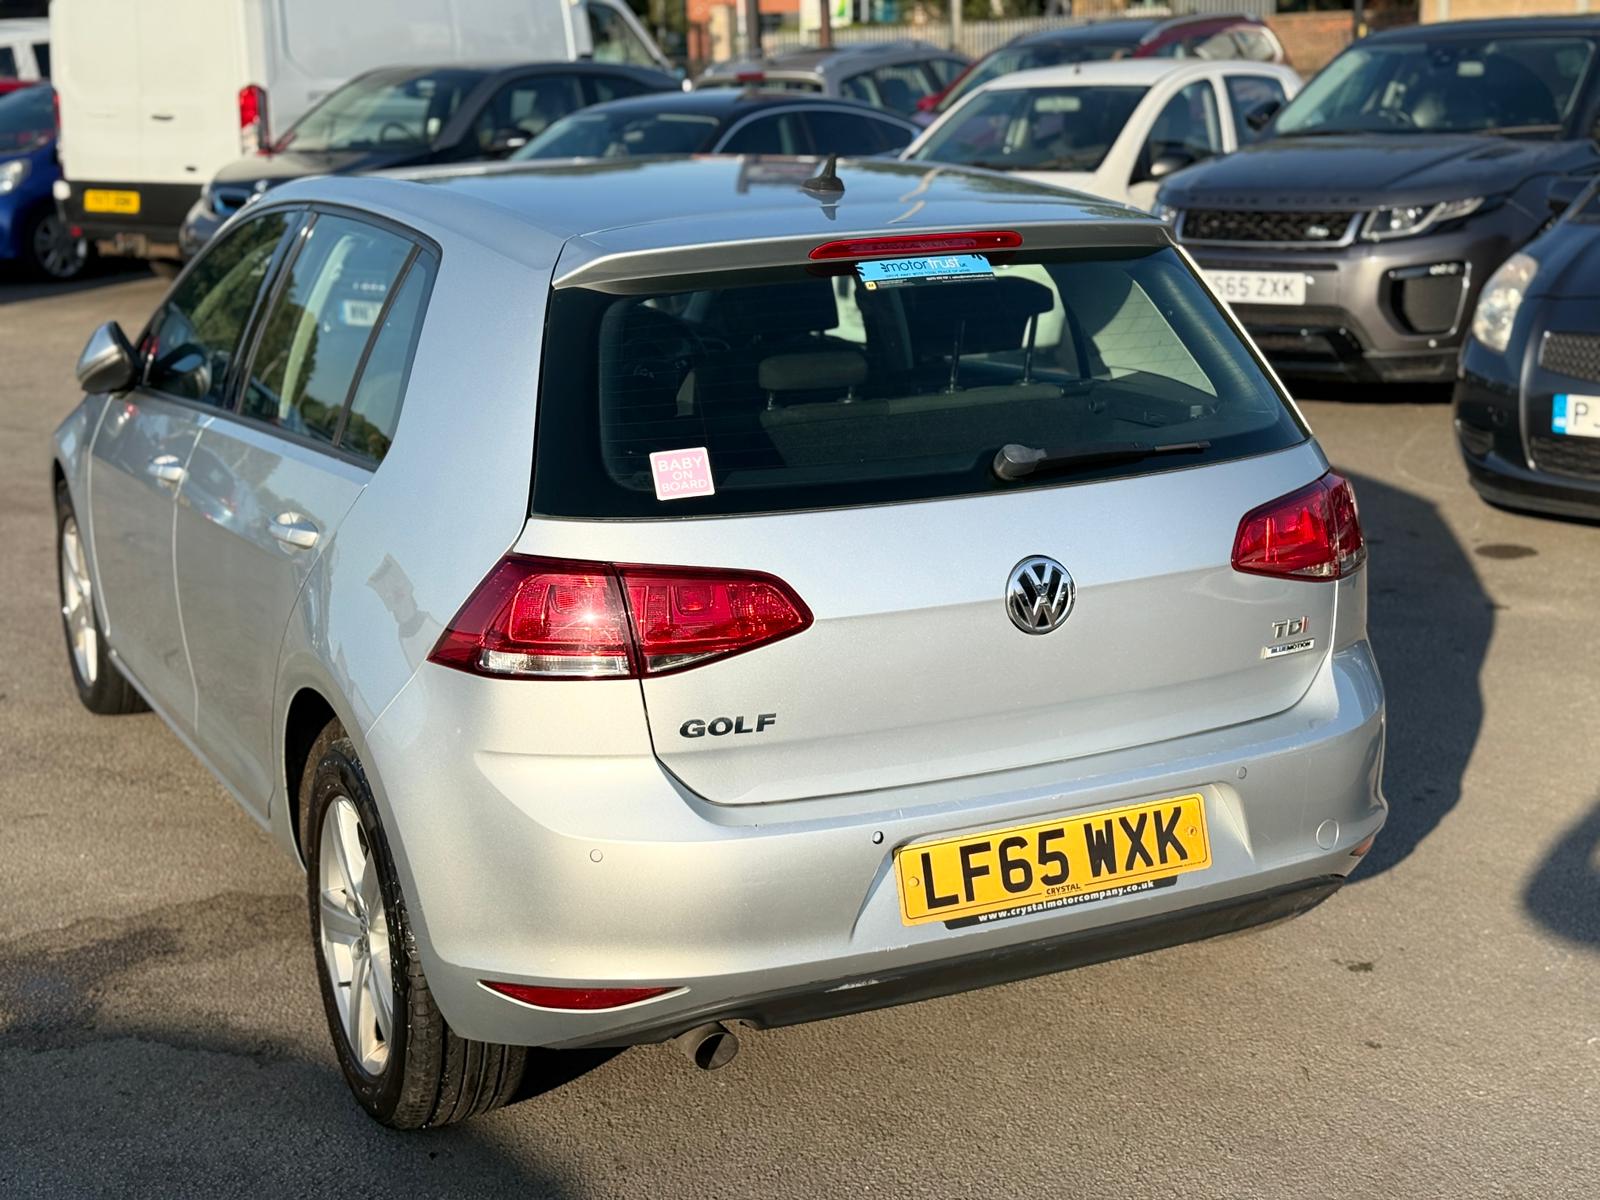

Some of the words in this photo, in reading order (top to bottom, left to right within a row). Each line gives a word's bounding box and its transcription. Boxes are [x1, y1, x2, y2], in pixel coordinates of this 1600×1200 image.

[1208, 275, 1250, 297] S65
[1256, 276, 1295, 299] ZXK
[658, 456, 703, 472] BABY
[672, 470, 693, 480] ON
[662, 479, 707, 492] BOARD
[1271, 616, 1309, 639] TDI
[679, 713, 777, 738] GOLF
[920, 828, 1070, 910] LF65
[1083, 806, 1188, 878] WXK
[1046, 882, 1081, 895] CRYSTAL
[978, 880, 1155, 923] www.crystalmotorcompany.co.uk
